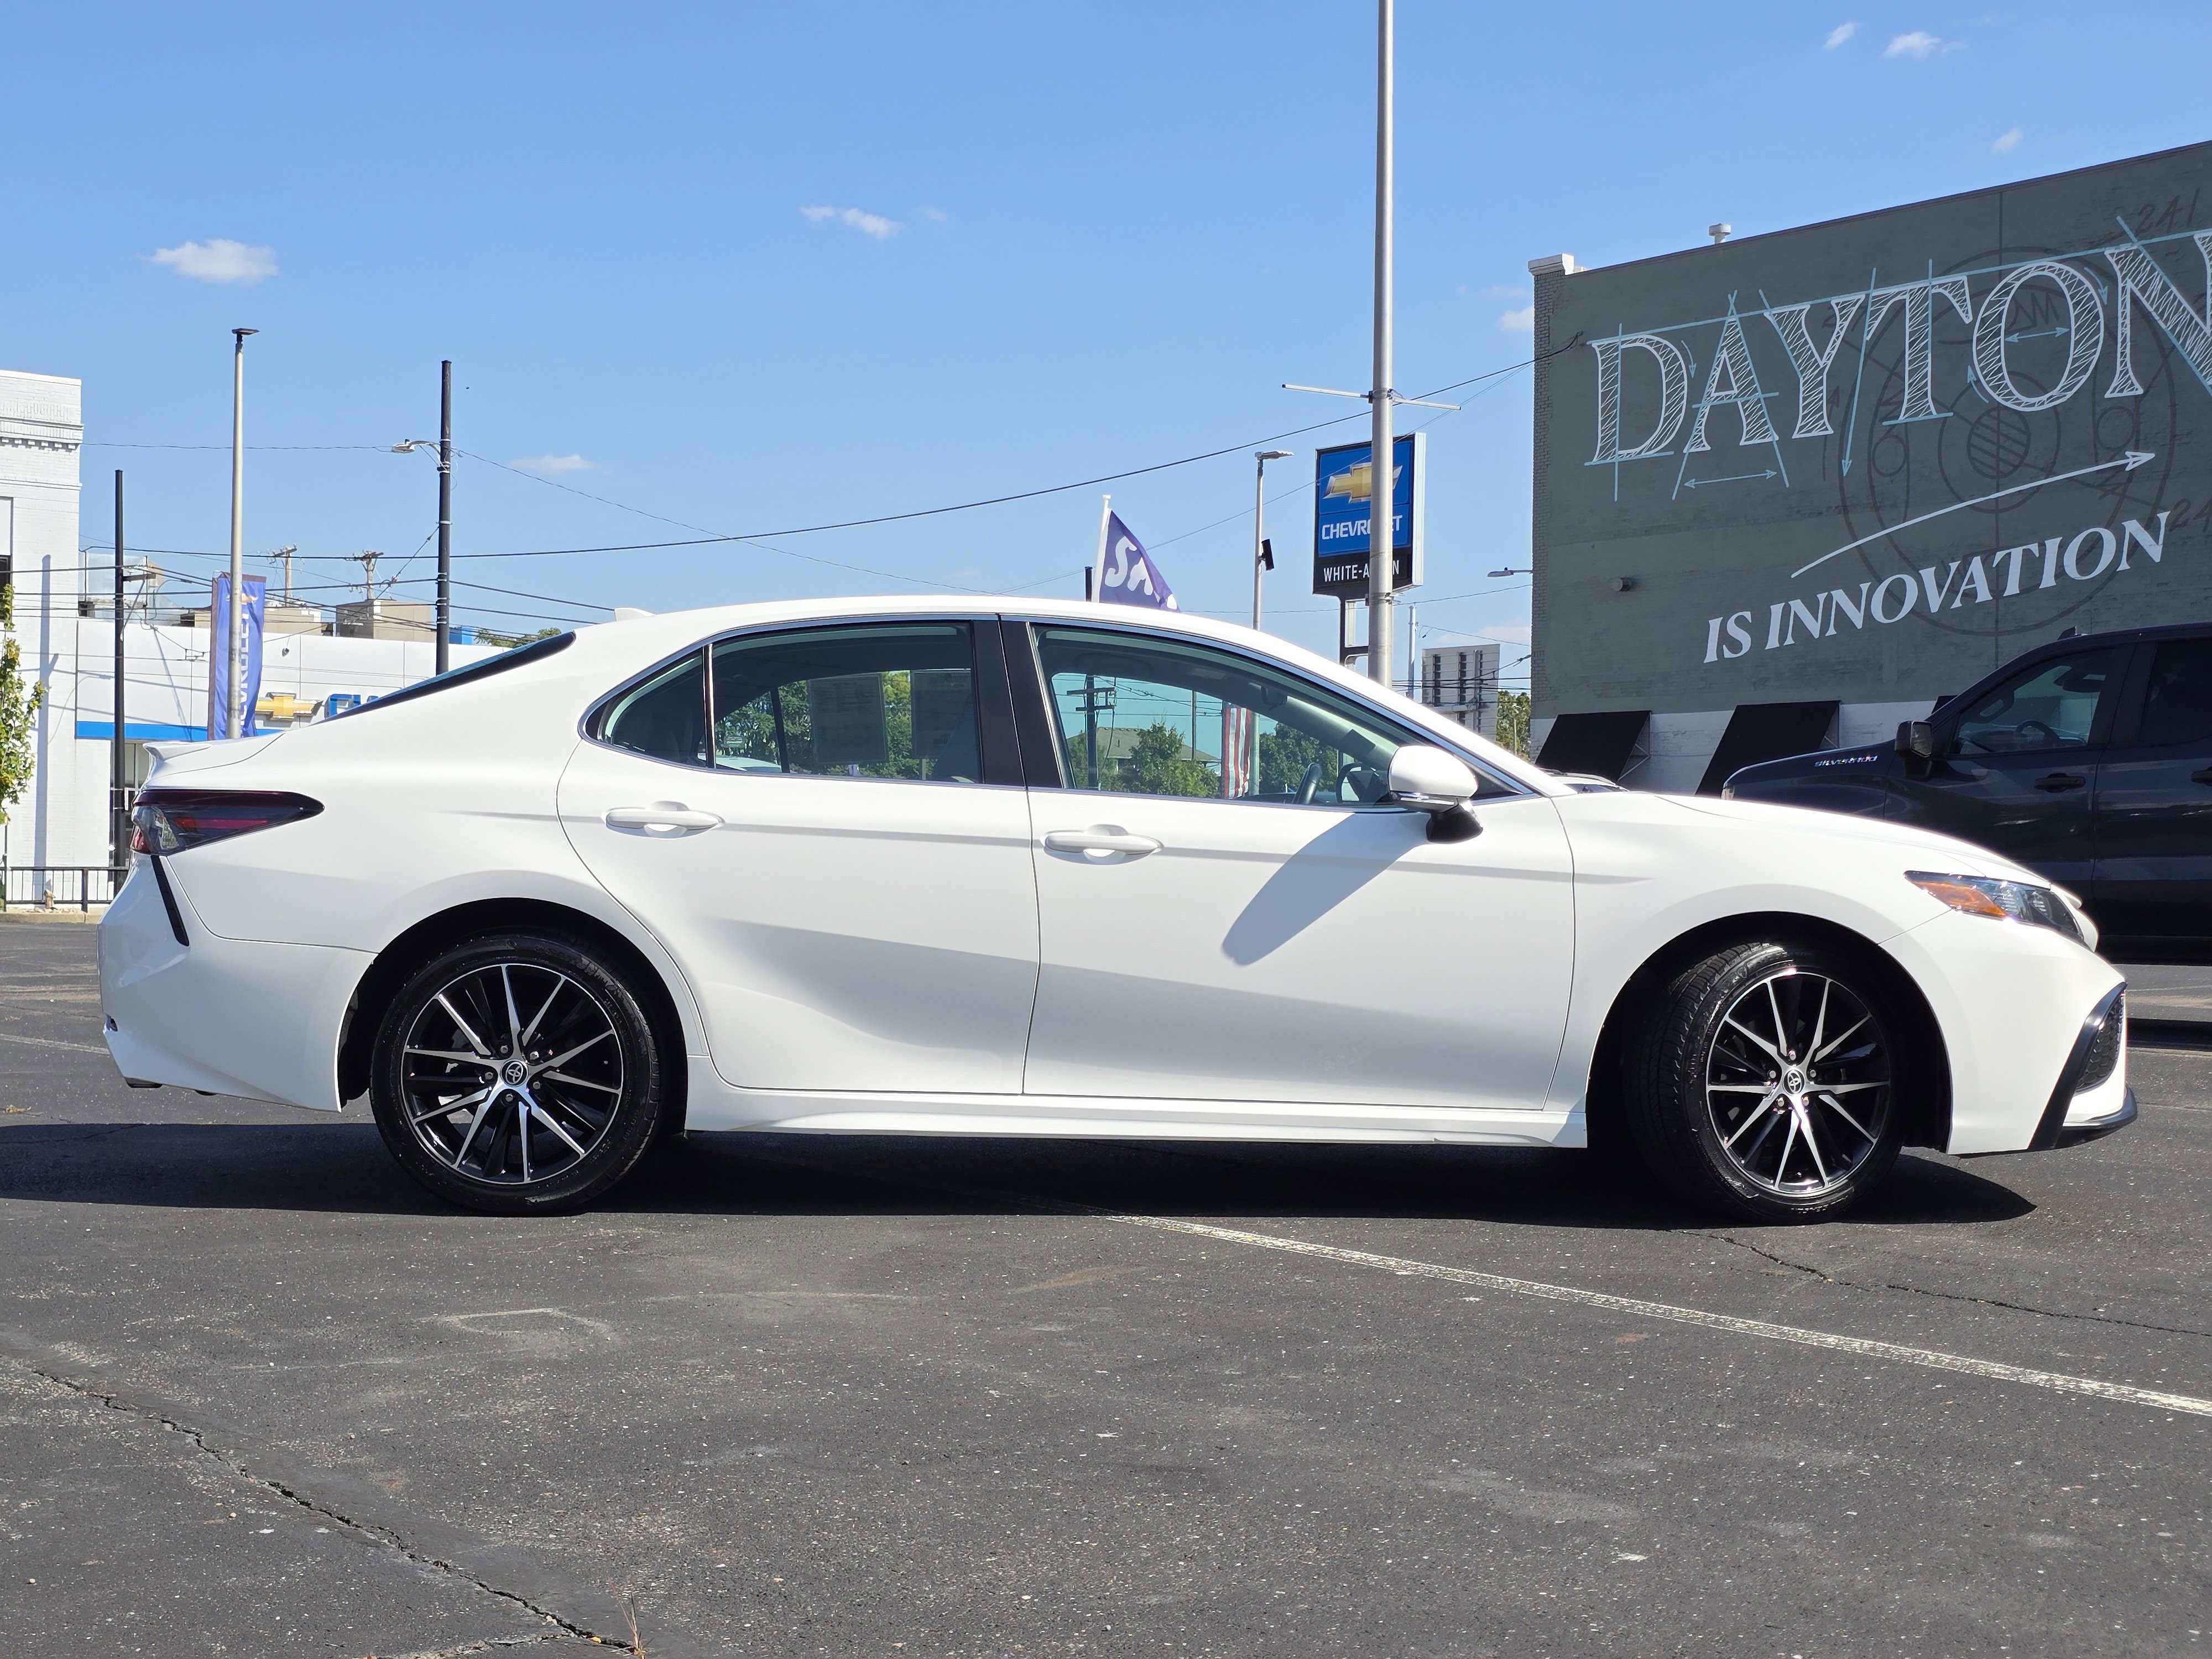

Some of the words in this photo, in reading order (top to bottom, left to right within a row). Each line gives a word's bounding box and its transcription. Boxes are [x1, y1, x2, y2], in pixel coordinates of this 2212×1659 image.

[1592, 231, 2212, 463] DAYTON
[1322, 515, 1403, 540] CHEVRT
[1323, 560, 1400, 582] WHITE-AN
[1703, 611, 1752, 664] IS
[1765, 510, 2171, 650] INNOVATION
